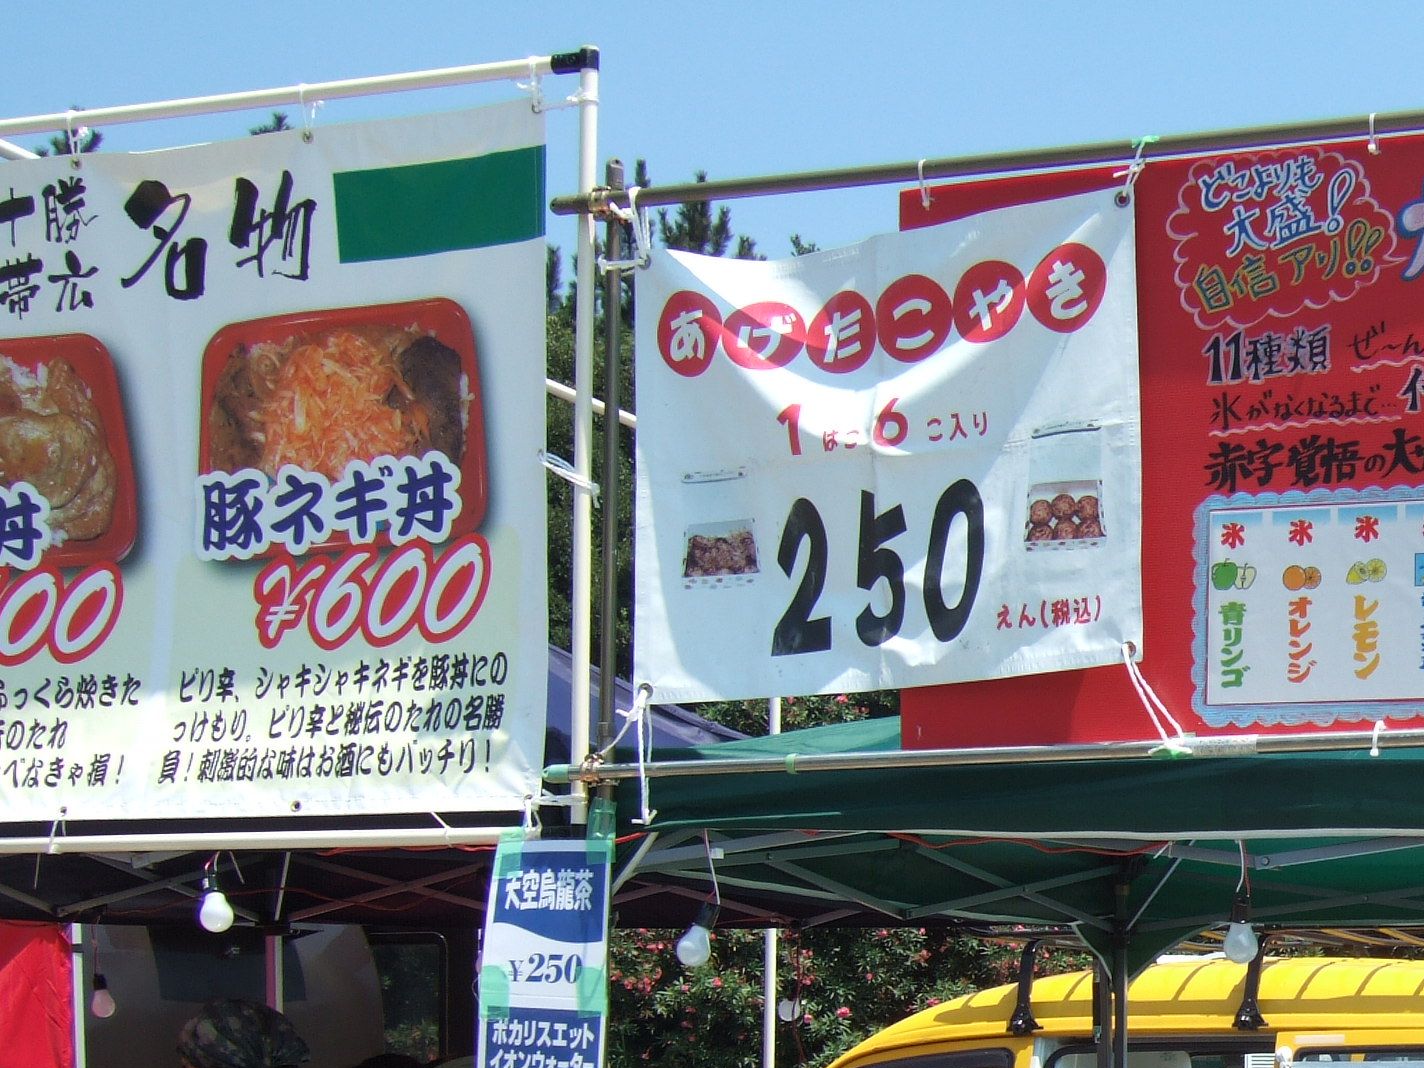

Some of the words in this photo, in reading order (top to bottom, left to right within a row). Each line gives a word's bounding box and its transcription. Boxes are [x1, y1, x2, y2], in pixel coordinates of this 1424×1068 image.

[1199, 156, 1324, 211] どこよりも
[121, 169, 317, 300] 名物
[667, 258, 1089, 364] あげたこやき
[1203, 325, 1332, 388] 11種類
[201, 459, 455, 554] 豚ネギ丼
[1220, 521, 1247, 550] 氷
[1288, 518, 1315, 547] 氷
[1354, 515, 1380, 543] 氷
[256, 535, 489, 648] ¥600
[770, 478, 985, 657] 250
[0, 562, 122, 664] 00
[1217, 601, 1252, 690] 青リンゴ
[1286, 596, 1317, 685] オレンジ
[1352, 595, 1380, 681] レモン
[508, 952, 582, 985] ¥250
[491, 1019, 596, 1050] ポカリスエット
